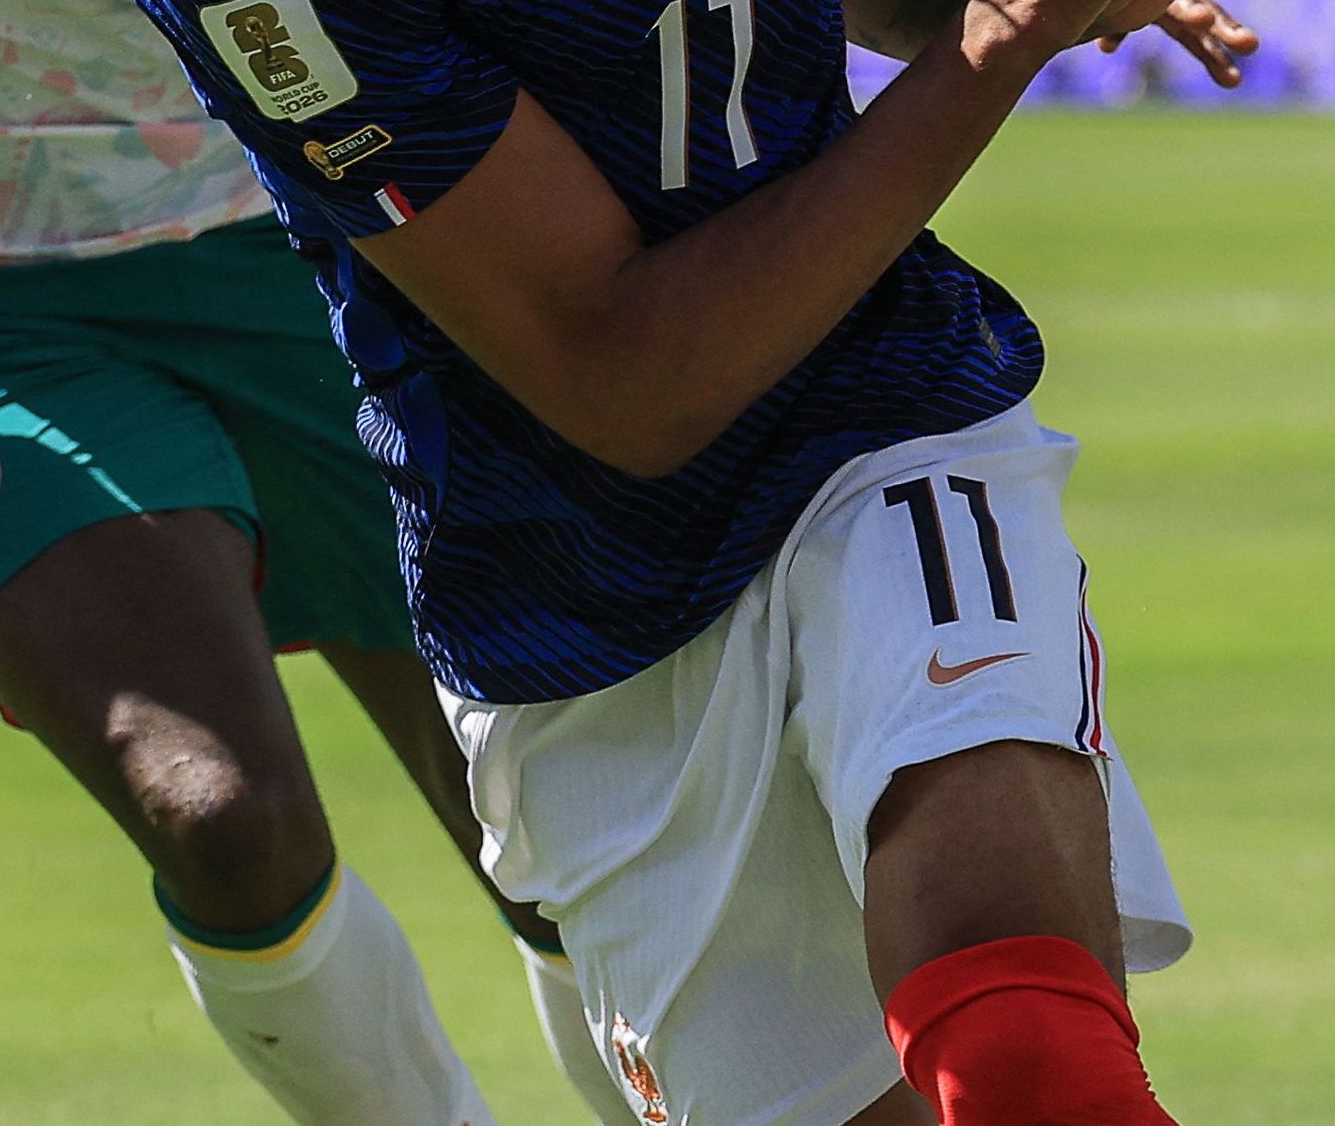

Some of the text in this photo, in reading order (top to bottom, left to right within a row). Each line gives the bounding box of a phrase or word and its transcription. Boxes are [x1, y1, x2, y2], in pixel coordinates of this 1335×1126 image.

[270, 70, 297, 85] FIFA
[300, 81, 320, 94] CUP
[328, 130, 373, 159] DEBUT
[882, 474, 1018, 626] 11
